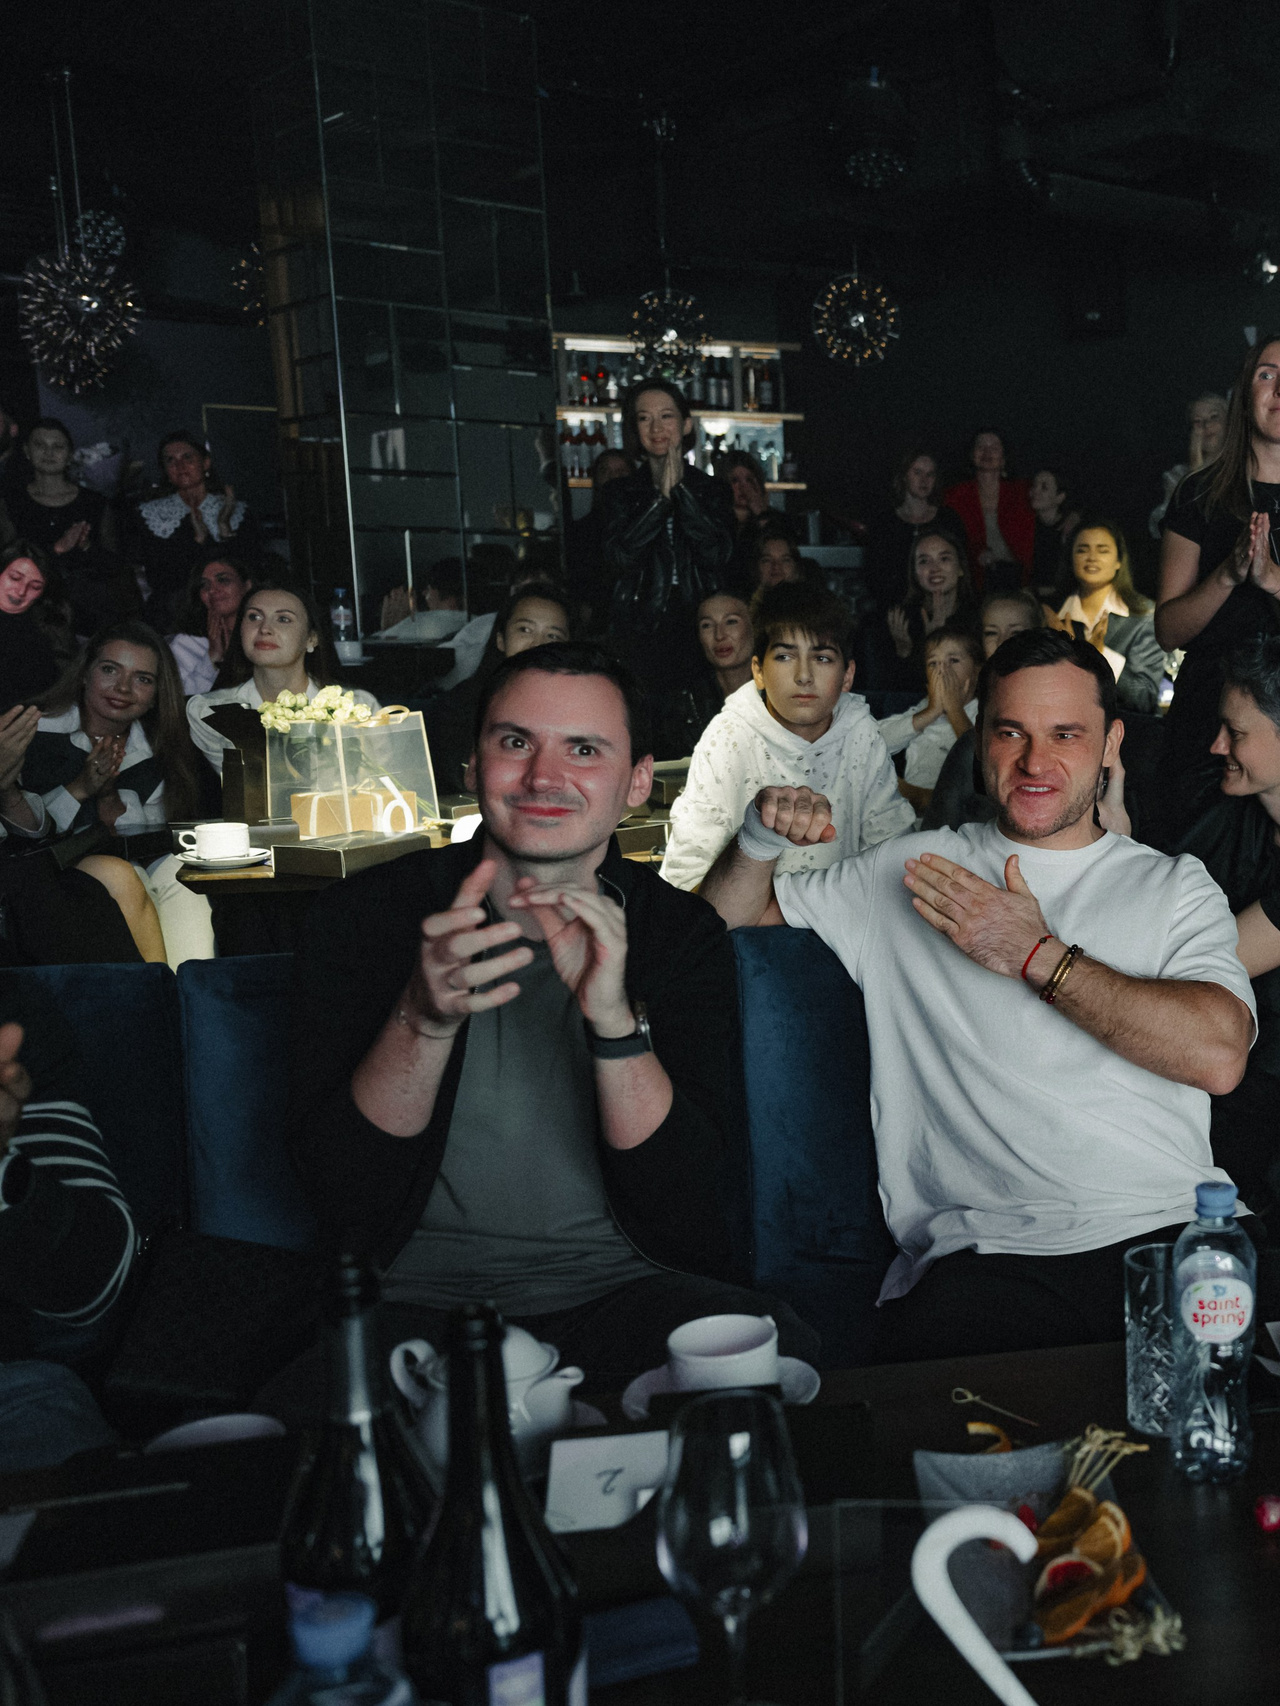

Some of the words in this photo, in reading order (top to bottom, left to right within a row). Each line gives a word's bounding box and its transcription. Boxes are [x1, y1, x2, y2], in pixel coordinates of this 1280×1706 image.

[1198, 1297, 1240, 1310] saint
[1192, 1311, 1245, 1328] spring
[595, 1467, 625, 1496] 2
